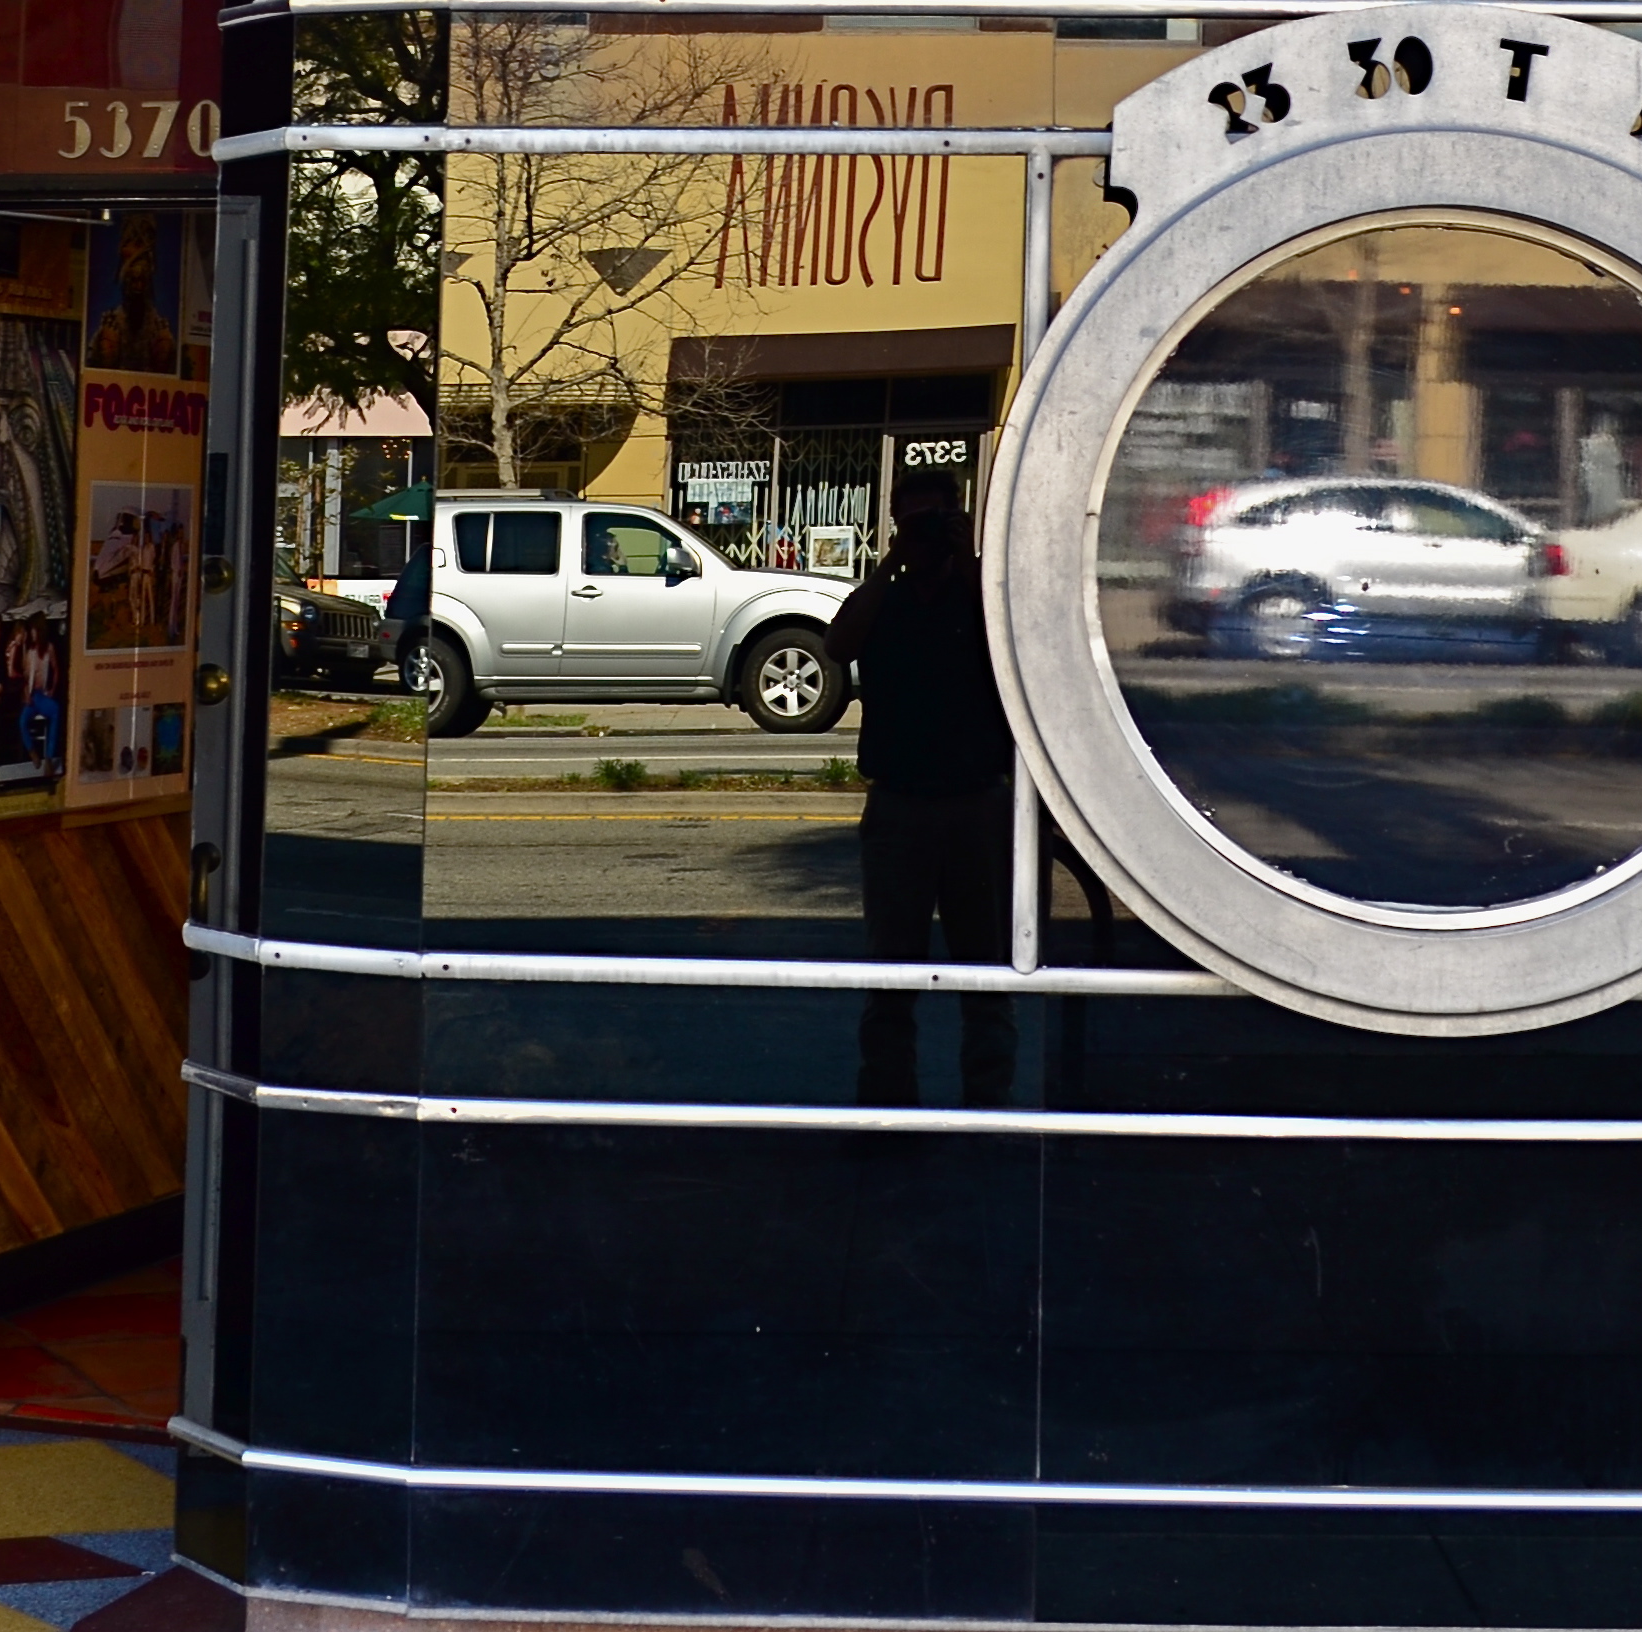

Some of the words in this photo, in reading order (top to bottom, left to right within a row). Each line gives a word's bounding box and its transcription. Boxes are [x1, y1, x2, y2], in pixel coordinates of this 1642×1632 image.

[1347, 35, 1434, 101] 30
[1499, 38, 1550, 104] T
[57, 99, 222, 159] 5370
[84, 383, 207, 436] FOGHAT
